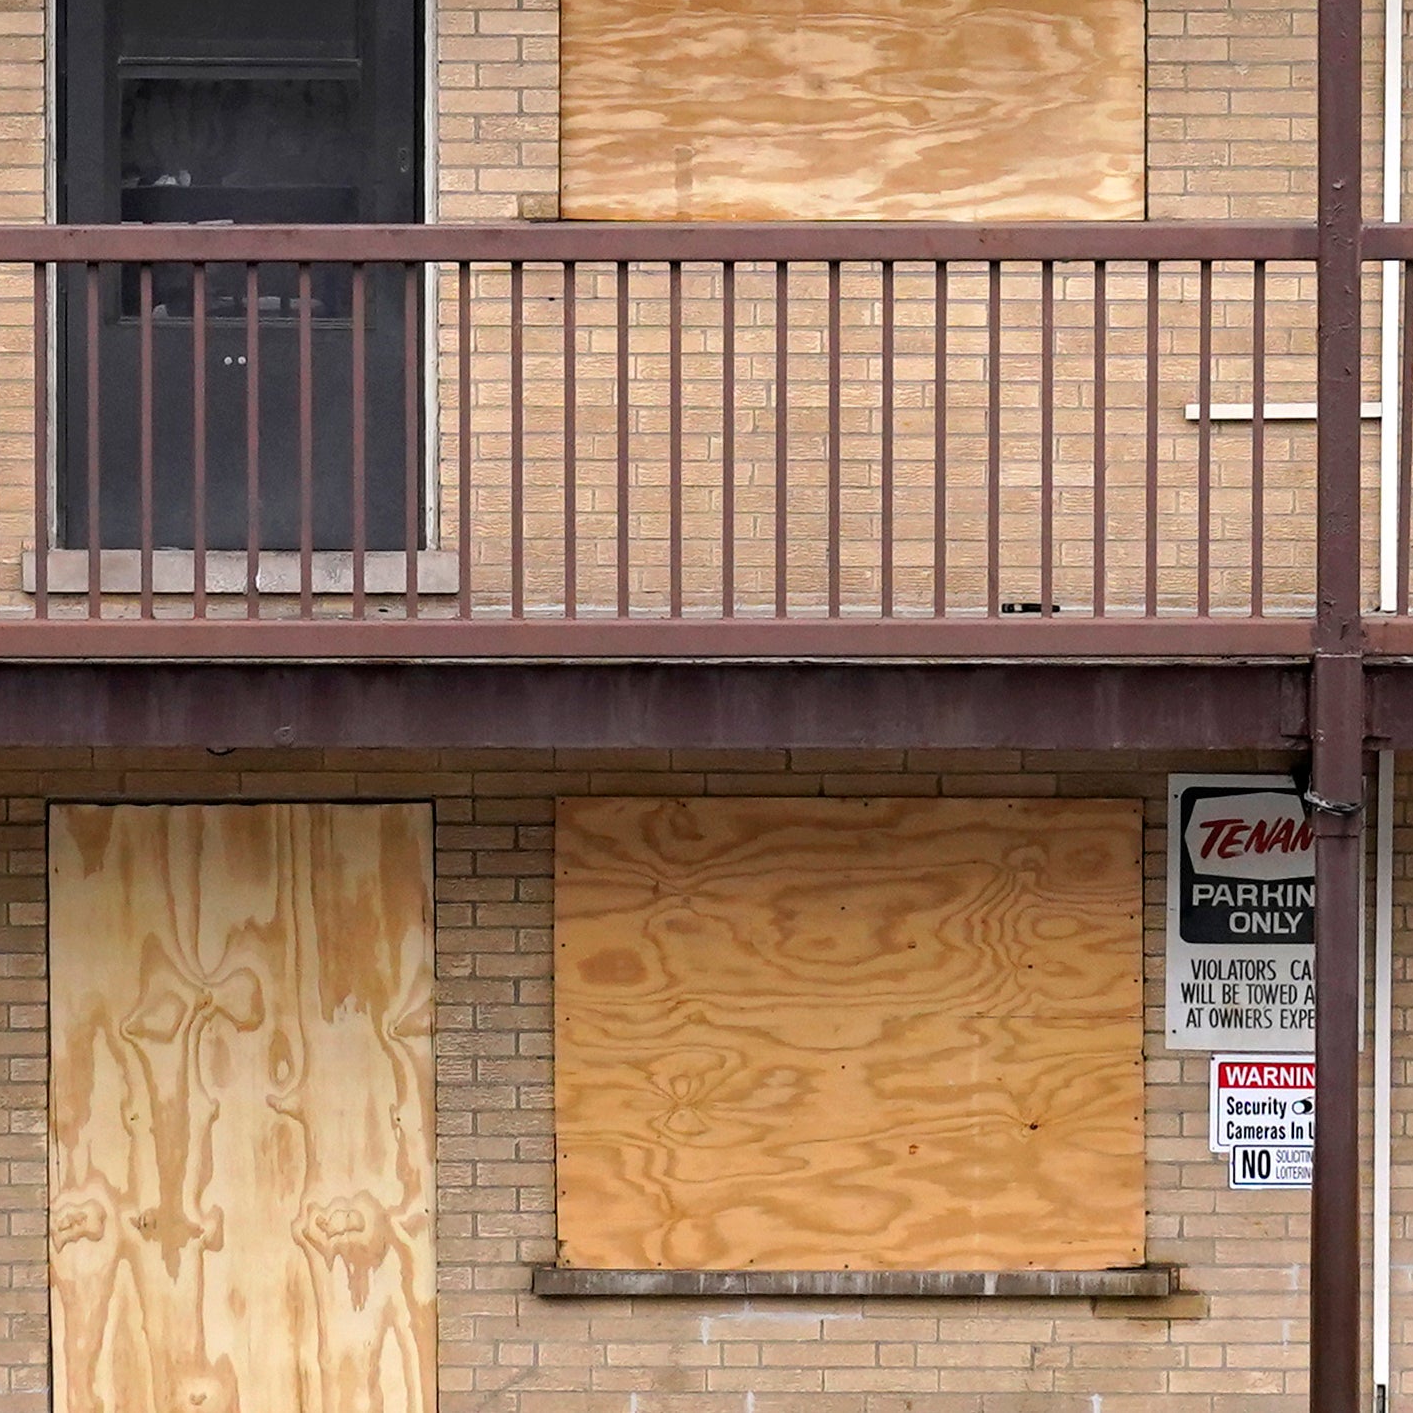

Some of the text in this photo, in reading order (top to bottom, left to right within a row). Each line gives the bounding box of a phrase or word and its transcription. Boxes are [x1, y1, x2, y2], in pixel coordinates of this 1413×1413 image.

[1199, 817, 1314, 859] TENAN
[1192, 884, 1315, 907] PARKIN
[1229, 911, 1304, 934] ONLY
[1191, 959, 1315, 981] VIOLATORS CA
[1181, 983, 1216, 1005] WILL
[1222, 983, 1240, 1005] BE
[1246, 983, 1298, 1005] TOWED
[1186, 1007, 1315, 1029] AT OWNER'S EXPE
[1225, 1066, 1315, 1087] WARNIN
[1227, 1096, 1287, 1120] Security
[1227, 1121, 1286, 1140] Cameras
[1291, 1121, 1304, 1140] In
[1242, 1149, 1271, 1179] NO
[1275, 1150, 1312, 1163] SOLICITIN
[1275, 1166, 1311, 1180] LOITERIN
